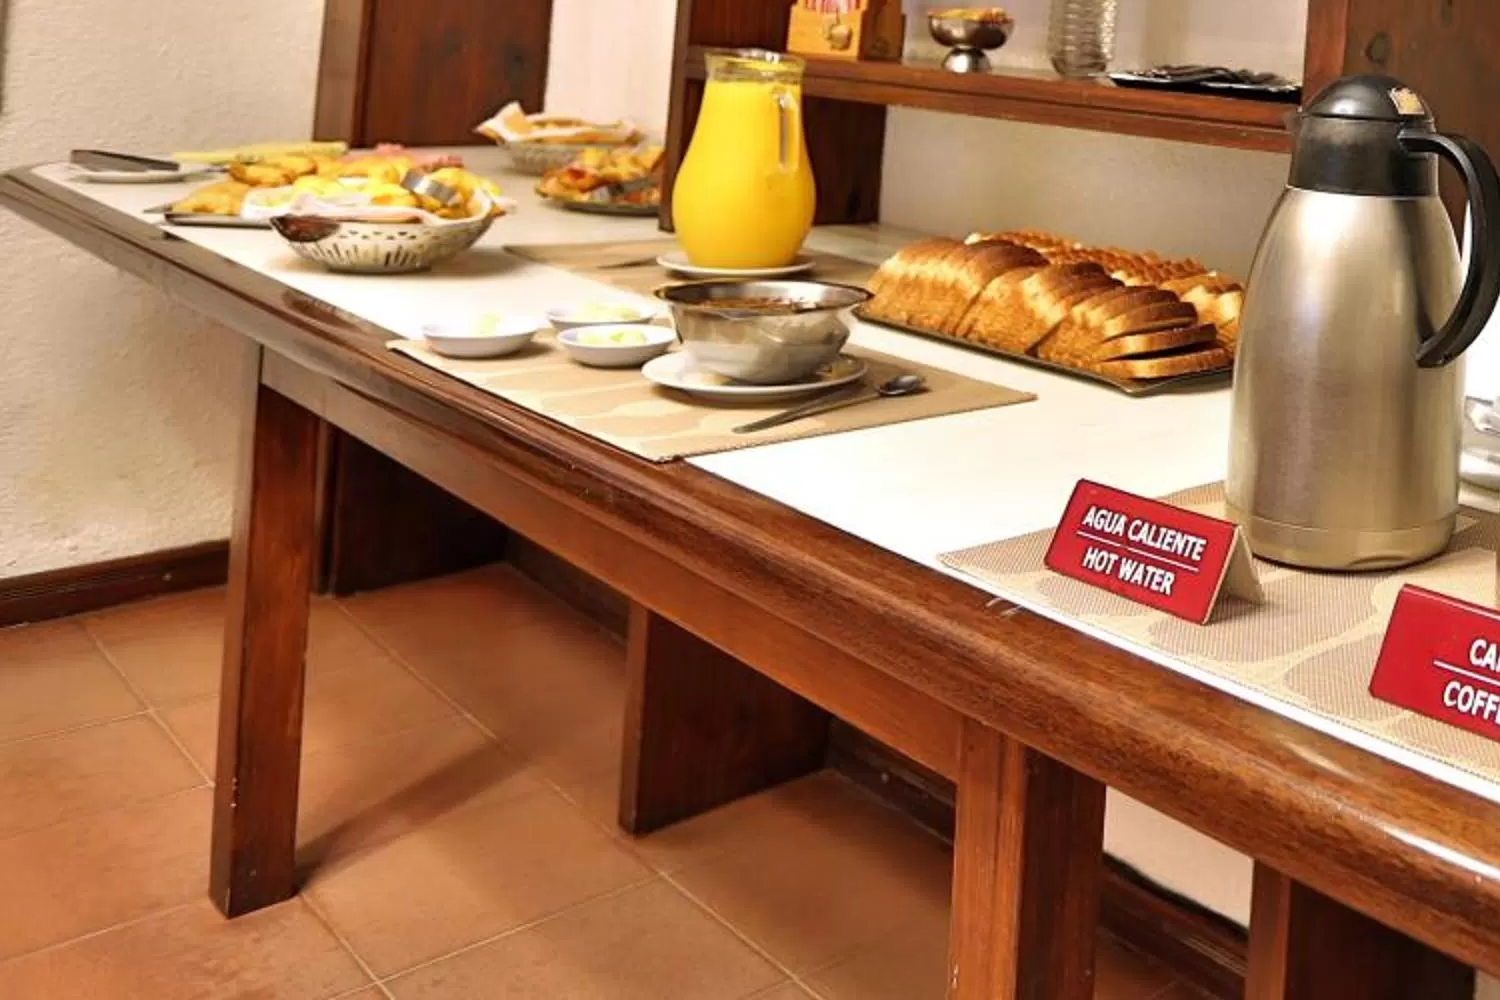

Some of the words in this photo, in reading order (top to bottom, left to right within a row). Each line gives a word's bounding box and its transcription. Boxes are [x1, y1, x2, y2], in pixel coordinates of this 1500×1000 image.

[1082, 505, 1126, 537] AGUA
[1127, 518, 1207, 561] CALIENTE
[1082, 546, 1120, 576] HOT
[1119, 557, 1176, 596] WATER
